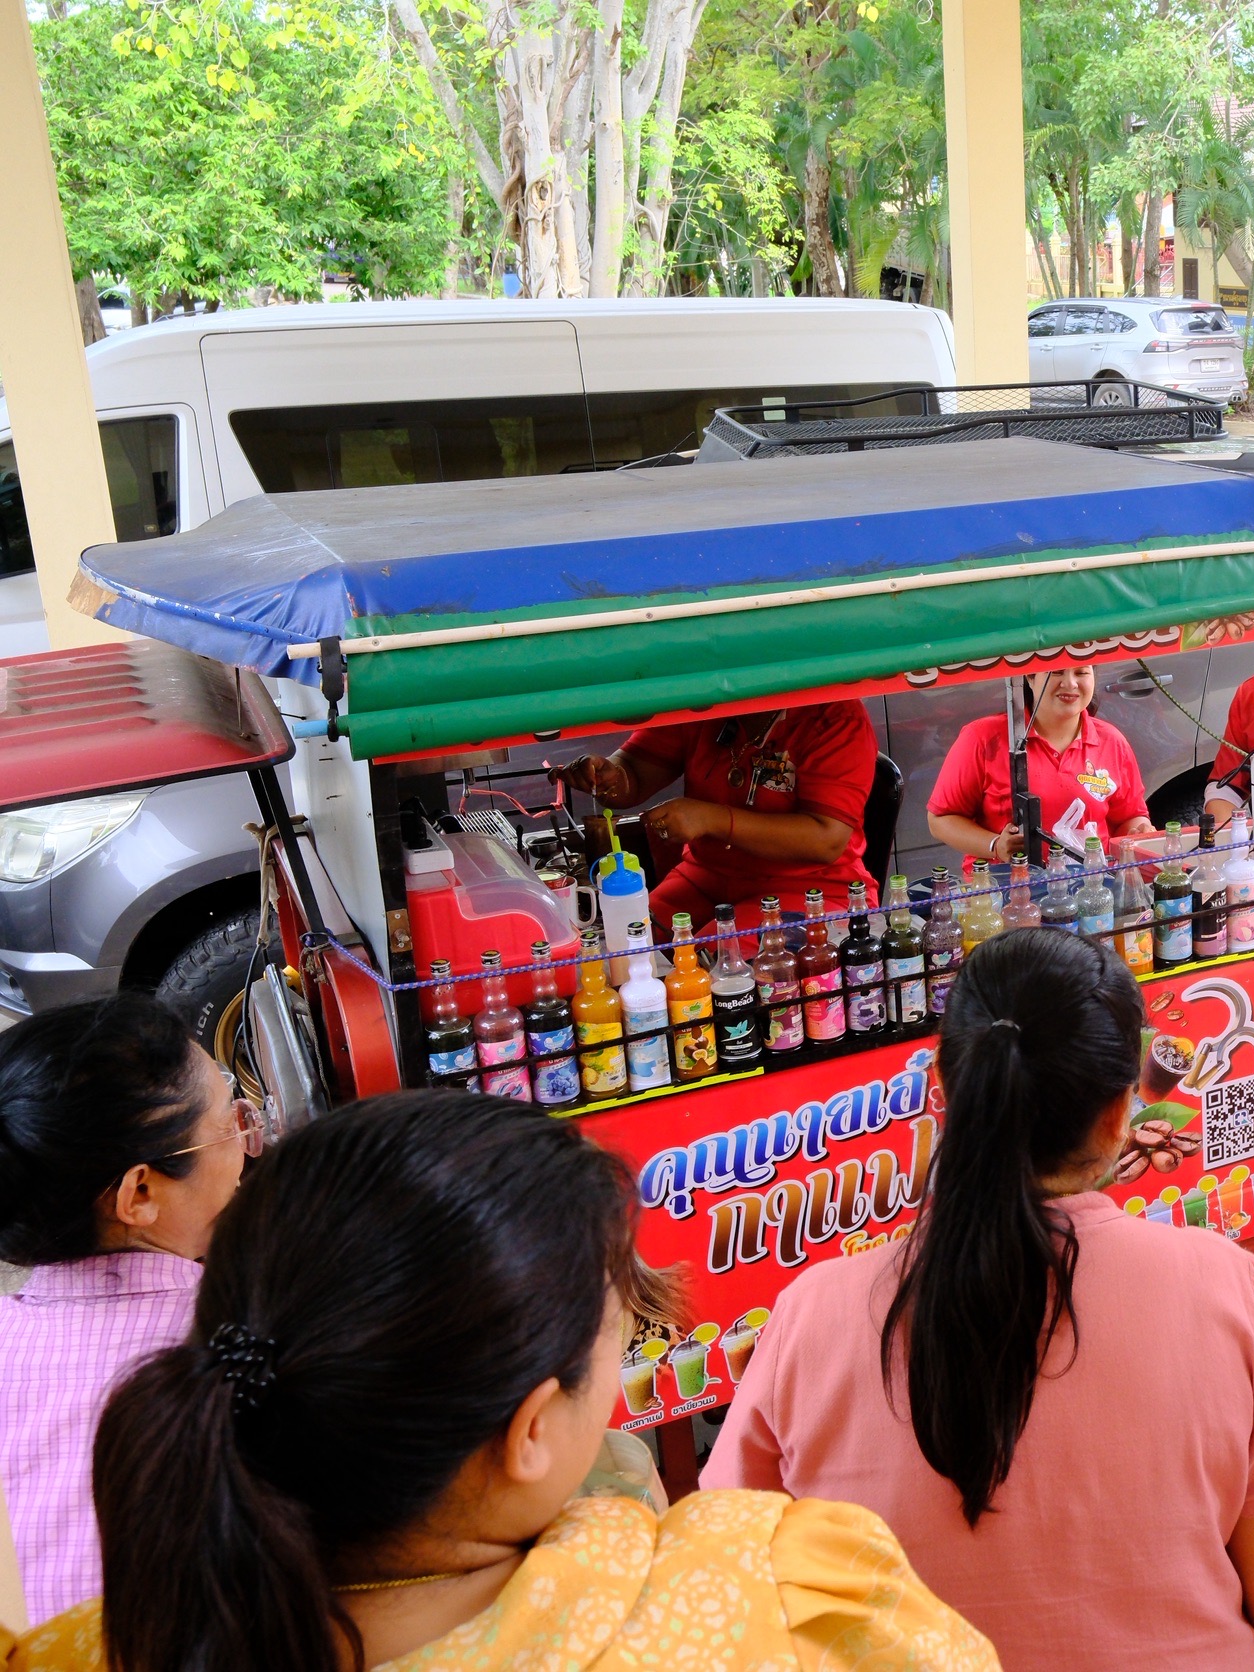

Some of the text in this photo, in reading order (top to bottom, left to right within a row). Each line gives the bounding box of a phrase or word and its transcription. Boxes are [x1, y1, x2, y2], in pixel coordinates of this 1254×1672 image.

[714, 993, 754, 1009] LongBeach
[672, 1395, 716, 1416] ชาเขียวนม
[622, 1411, 664, 1431] เนสกาแฟ
